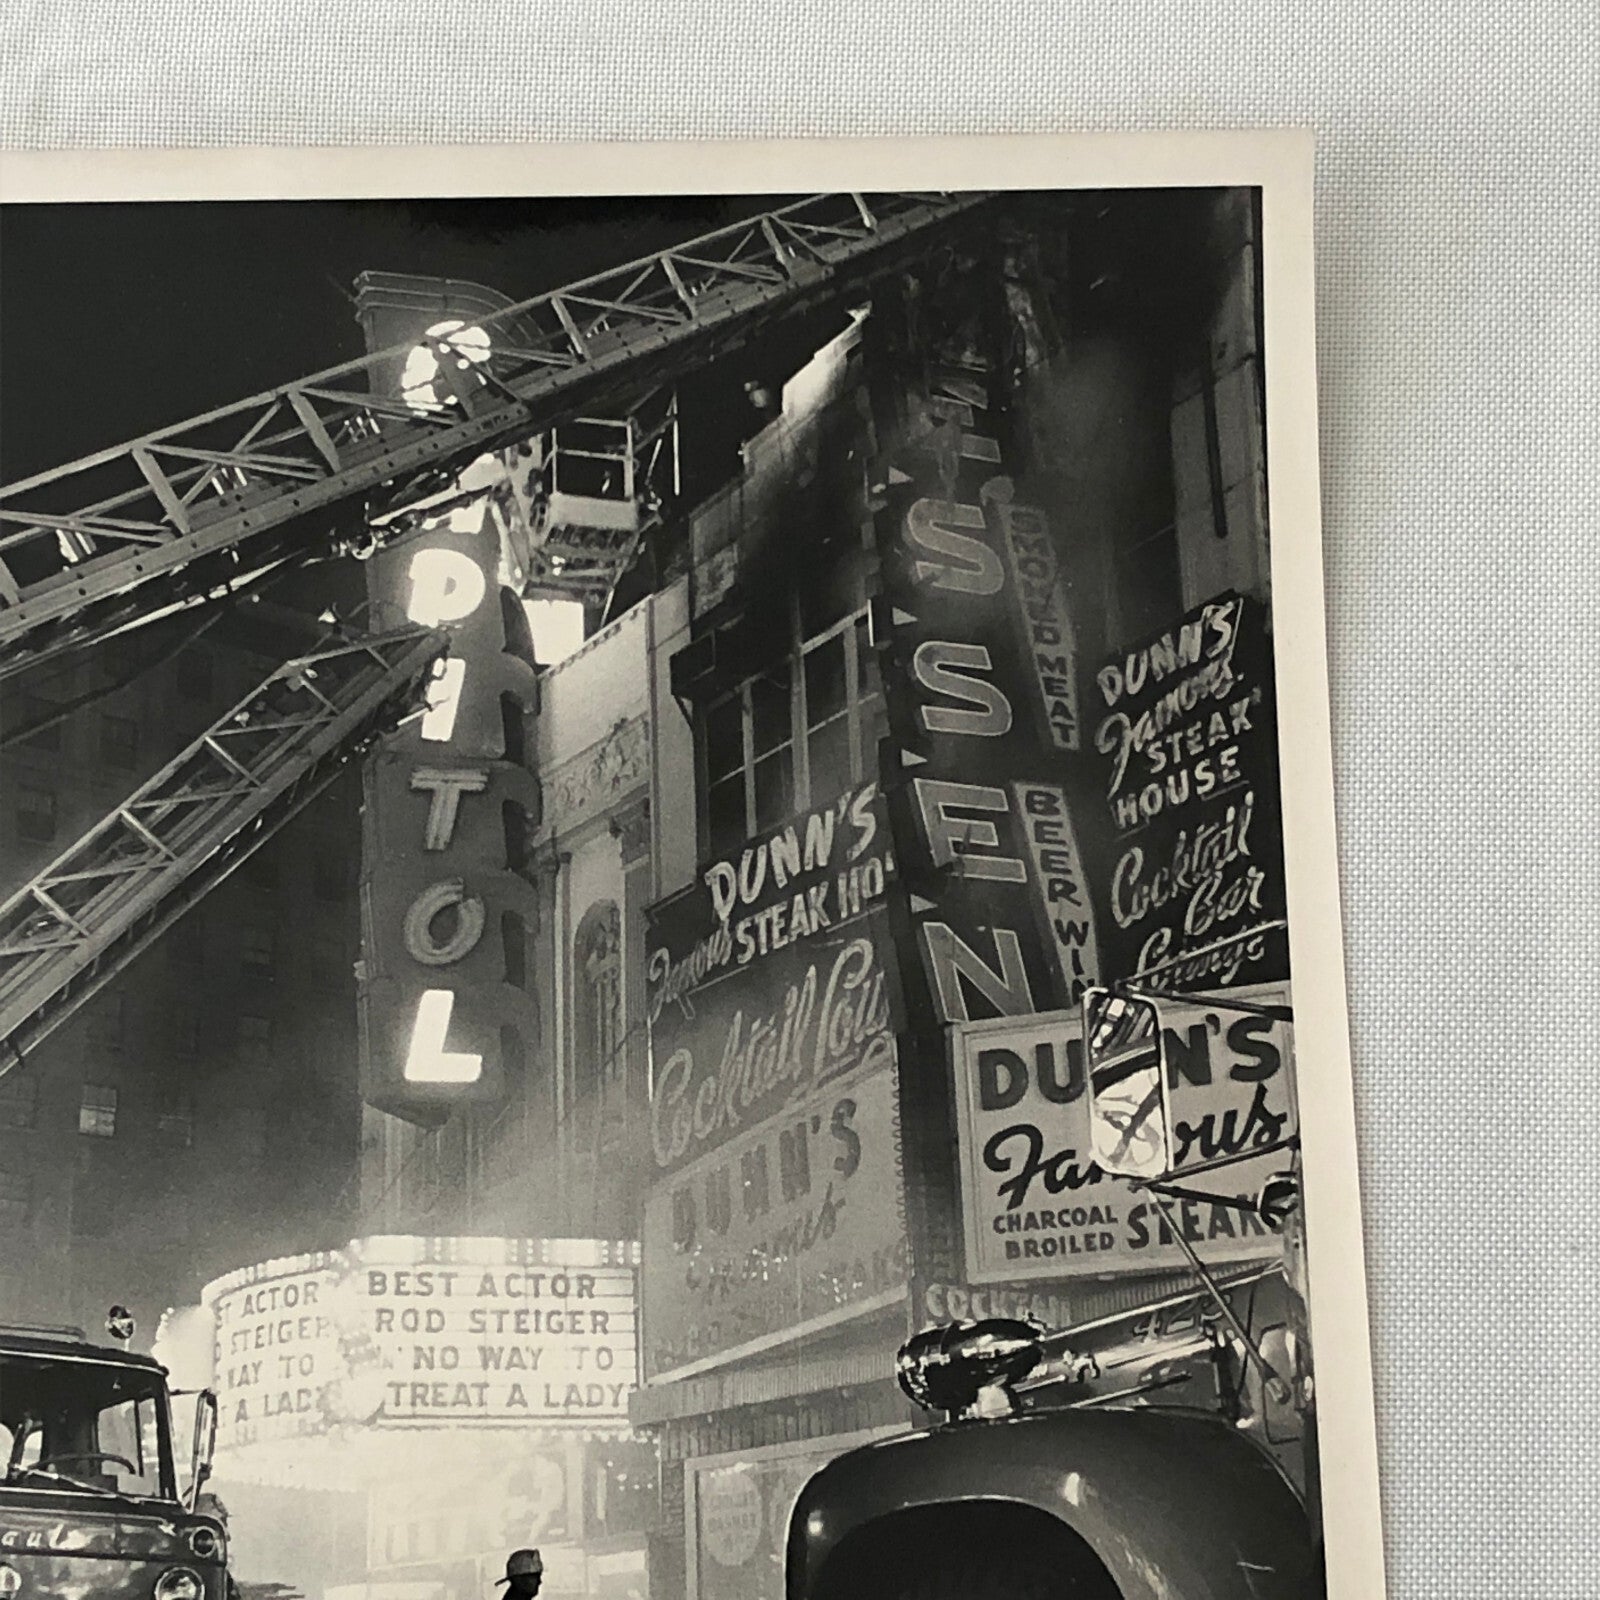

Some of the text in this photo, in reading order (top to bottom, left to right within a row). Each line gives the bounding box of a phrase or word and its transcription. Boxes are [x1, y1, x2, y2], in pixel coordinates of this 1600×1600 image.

[1034, 652, 1076, 744] MEAT
[1146, 691, 1254, 775] STEAK
[1113, 745, 1241, 828] HOUSE
[704, 781, 877, 922] DUNN'S
[1024, 789, 1082, 908] BEER
[734, 881, 832, 965] STEAK
[978, 1012, 1283, 1112] DUN'S
[992, 1205, 1119, 1235] CHARCOAL
[1126, 1192, 1286, 1250] STEAK
[1005, 1231, 1115, 1260] BROILED
[241, 1280, 319, 1318] ACTOR
[367, 1270, 596, 1300] BEST ACTOR
[375, 1307, 610, 1336] ROD STEIGER
[278, 1352, 314, 1379] TO
[477, 1345, 543, 1371] WAY
[570, 1345, 614, 1371] TO
[234, 1385, 324, 1424] A LAD
[387, 1381, 490, 1408] TREAT
[505, 1382, 529, 1408] A
